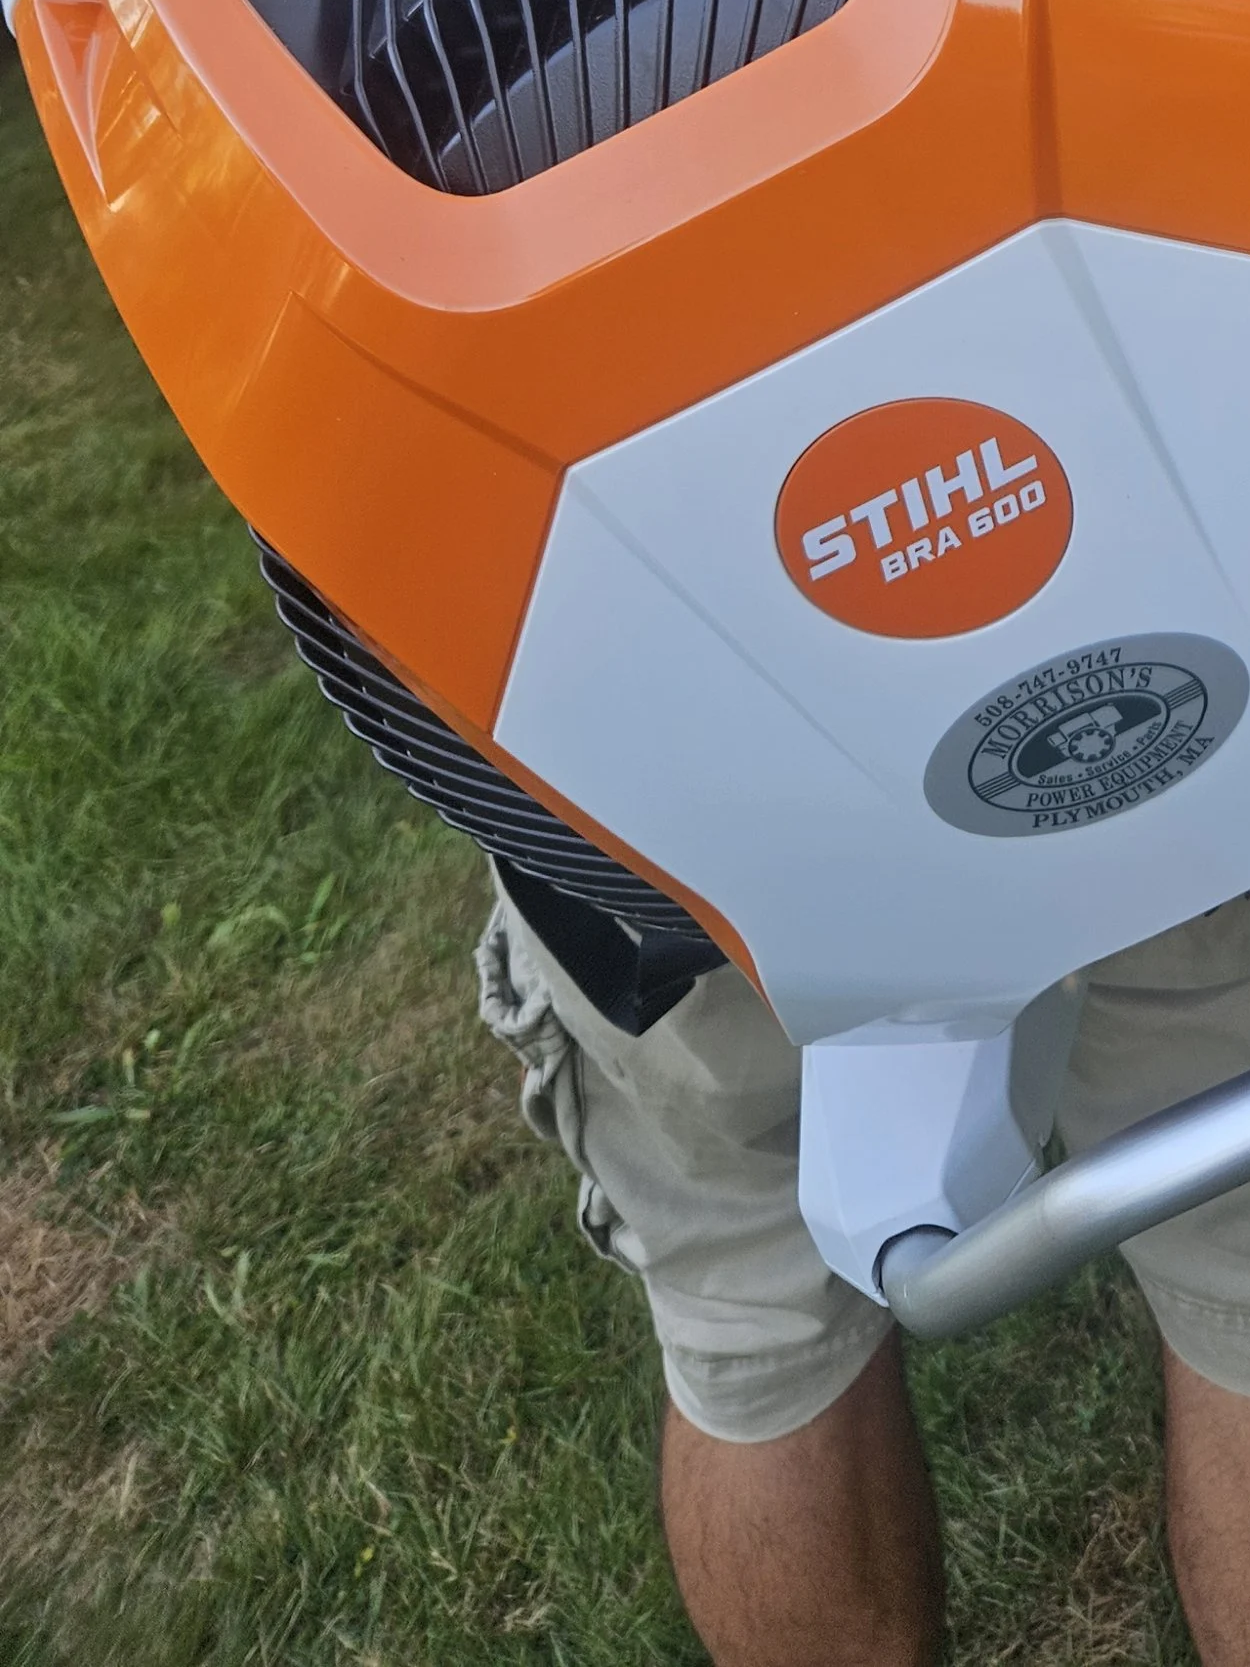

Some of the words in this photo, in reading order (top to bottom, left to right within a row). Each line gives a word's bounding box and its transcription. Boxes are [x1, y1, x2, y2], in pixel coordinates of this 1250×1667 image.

[802, 437, 1037, 581] STIHL
[880, 526, 962, 582] BRA
[967, 480, 1046, 538] 600
[974, 647, 1121, 727] 508-747-9747
[981, 667, 1152, 759] MORRISON'S
[1026, 783, 1095, 807] POWER
[1098, 719, 1193, 791] EQUIPMENT
[1032, 767, 1184, 828] PLYMOUTH,
[1177, 736, 1215, 766] MA
[1038, 773, 1073, 785] Sales
[1085, 750, 1131, 776] Service
